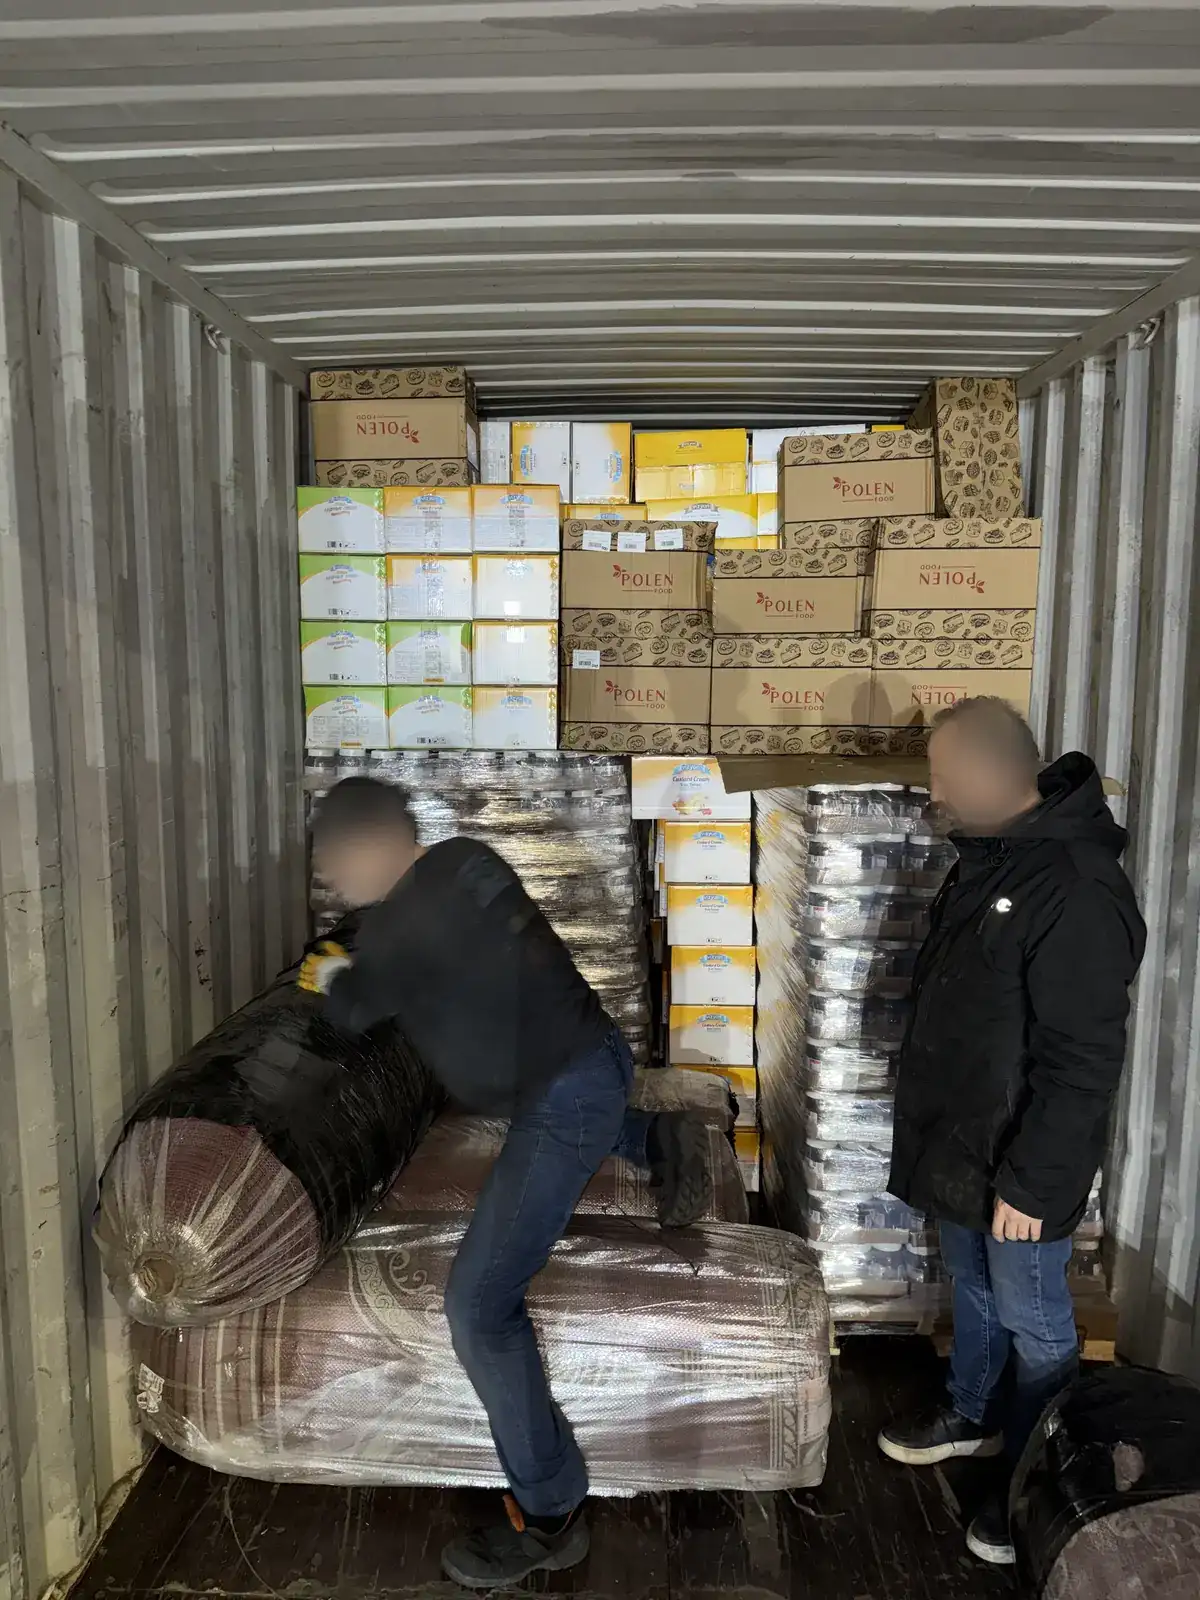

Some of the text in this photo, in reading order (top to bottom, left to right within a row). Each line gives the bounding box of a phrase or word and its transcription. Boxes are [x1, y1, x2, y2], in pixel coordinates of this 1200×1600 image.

[356, 421, 410, 435] POLEN
[841, 481, 894, 497] POLEN
[621, 573, 674, 587] POLEN
[919, 571, 976, 585] POLEN
[764, 599, 815, 612] POLEN
[614, 689, 665, 701] POLEN
[770, 691, 825, 704] POLEN
